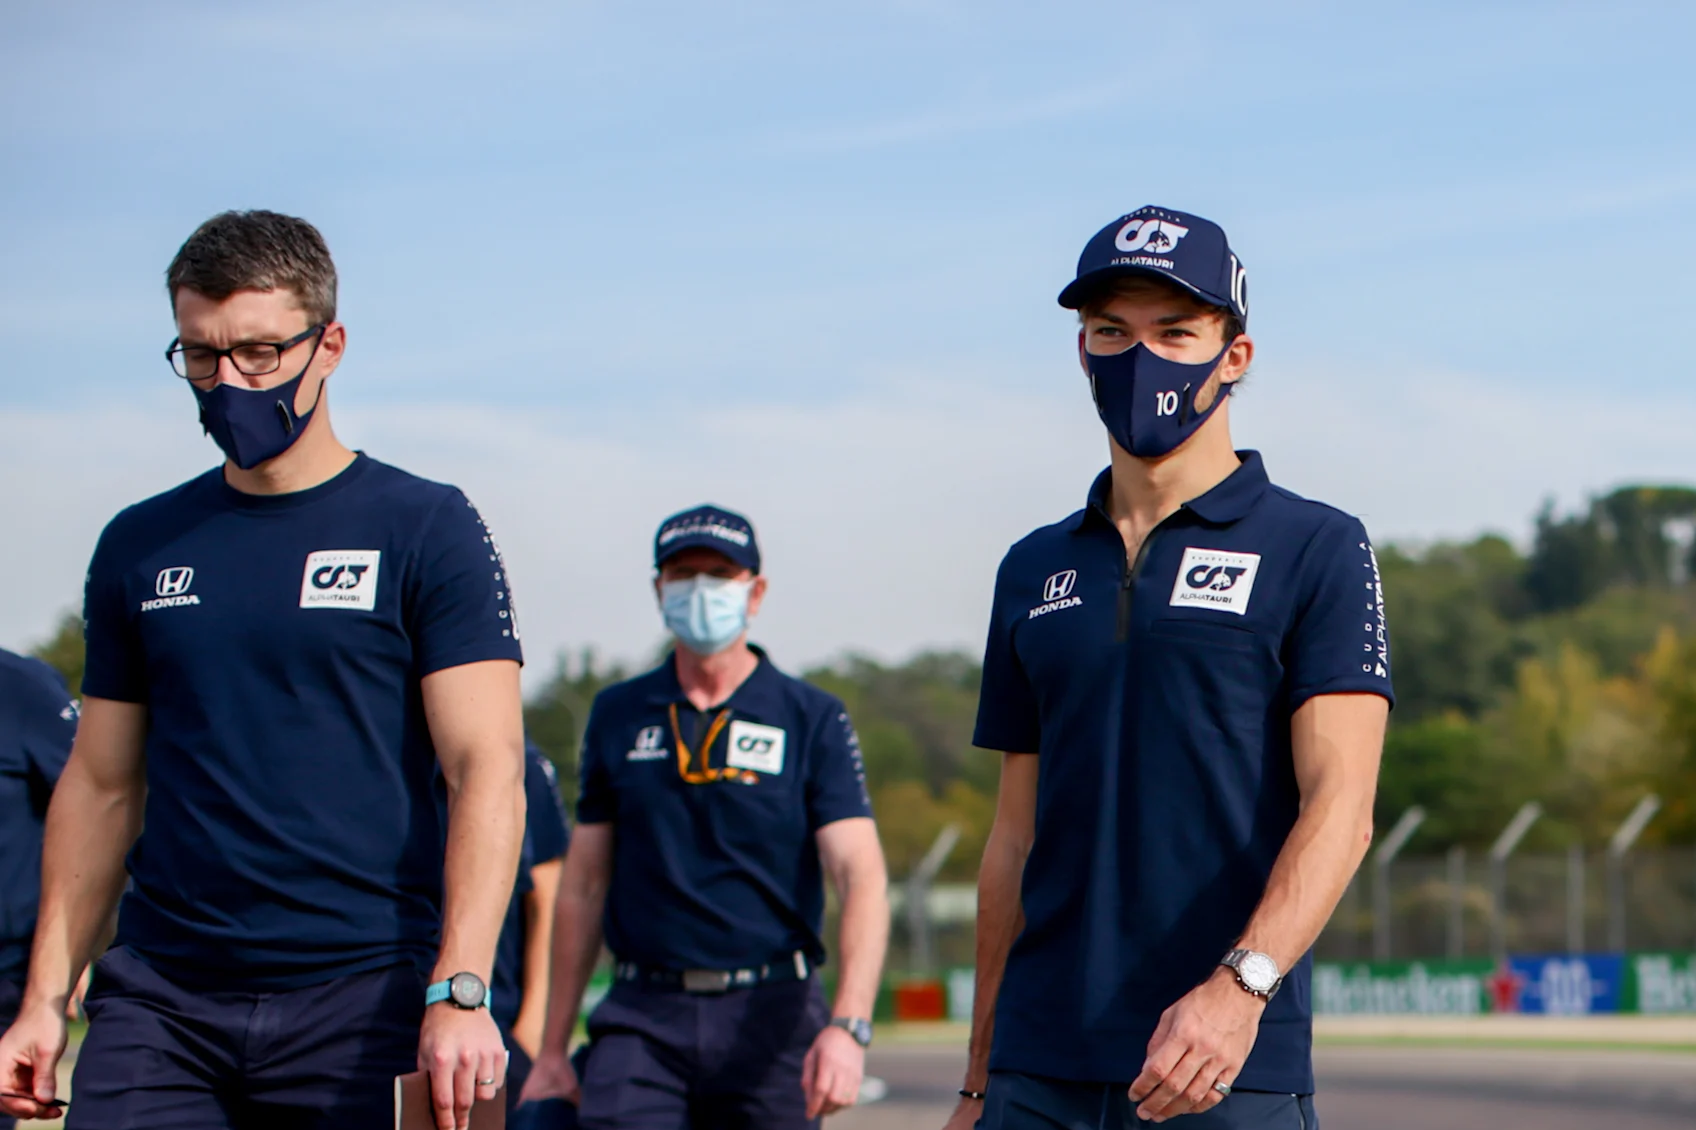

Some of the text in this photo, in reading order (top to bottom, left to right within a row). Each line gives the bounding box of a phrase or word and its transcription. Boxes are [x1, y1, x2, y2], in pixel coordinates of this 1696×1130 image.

[1156, 391, 1179, 416] 10
[140, 594, 201, 612] HONDA
[1027, 595, 1084, 620] HONDA
